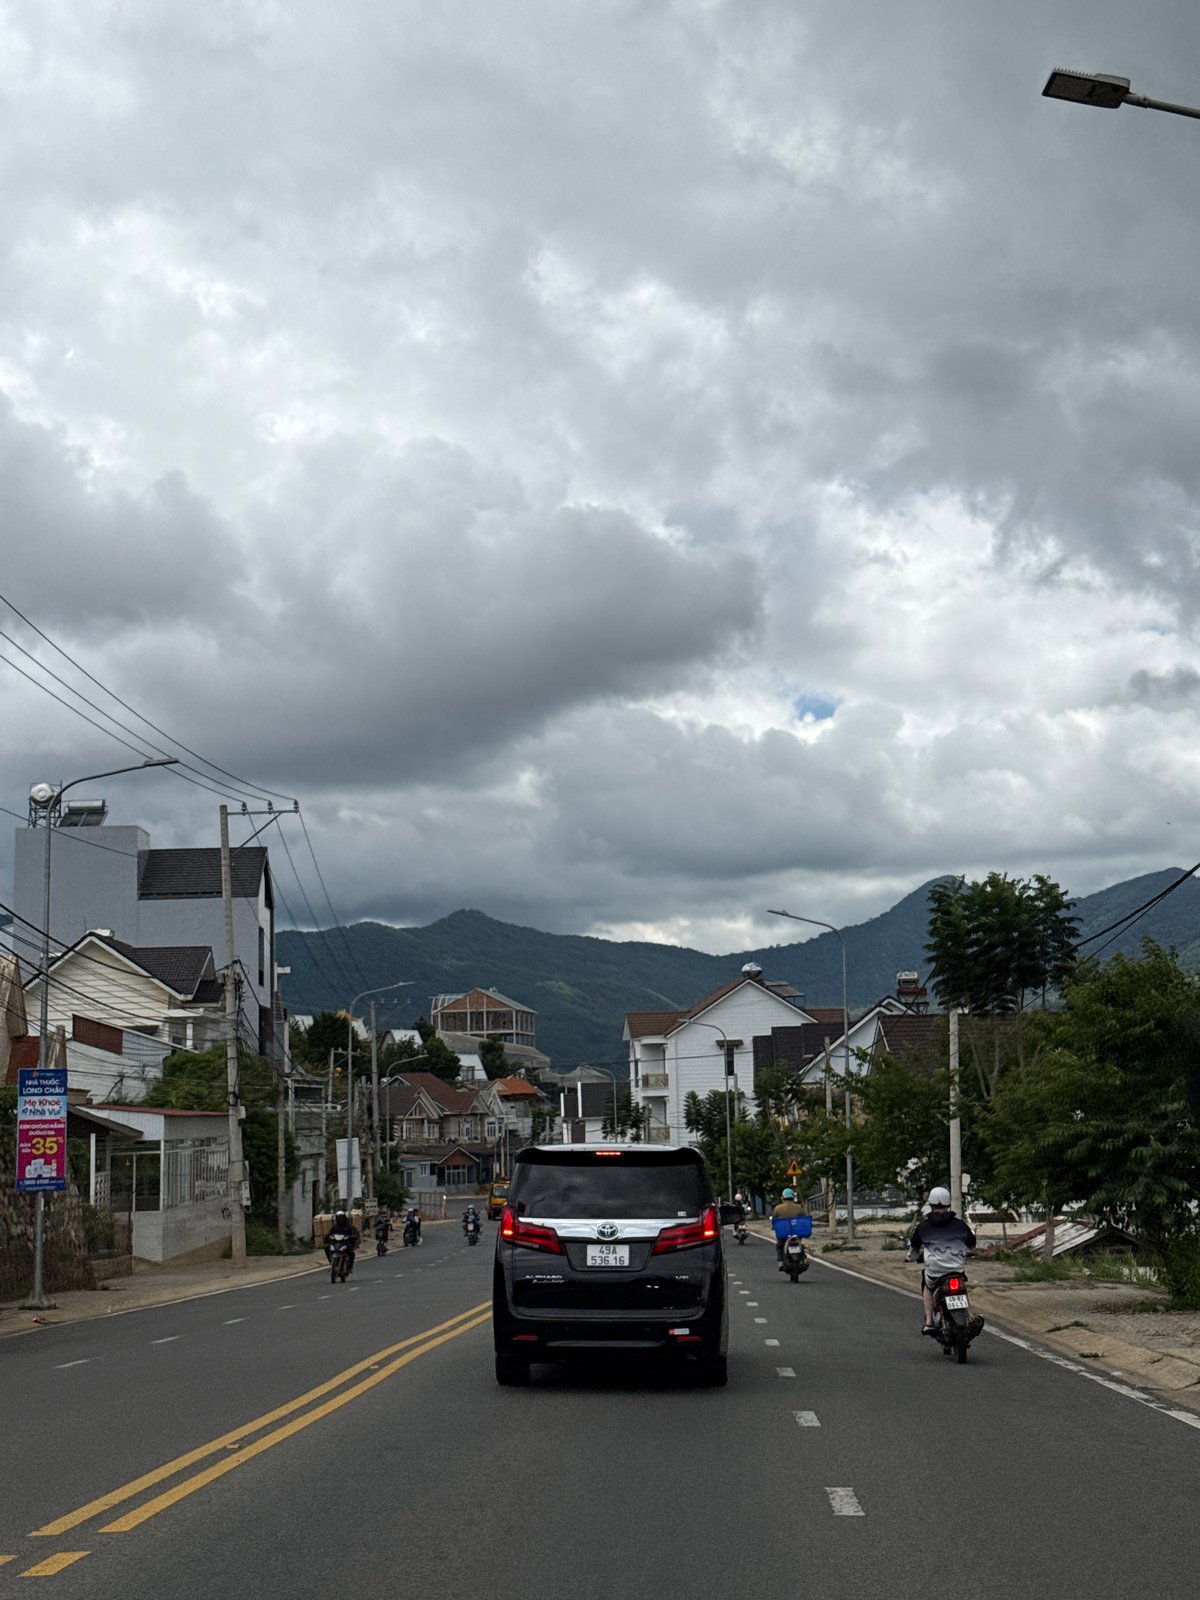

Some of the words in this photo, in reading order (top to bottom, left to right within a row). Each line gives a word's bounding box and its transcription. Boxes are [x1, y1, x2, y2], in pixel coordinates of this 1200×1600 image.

[44, 1086, 64, 1094] CHÂU
[599, 1245, 617, 1255] 49A
[591, 1256, 625, 1265] 536.16
